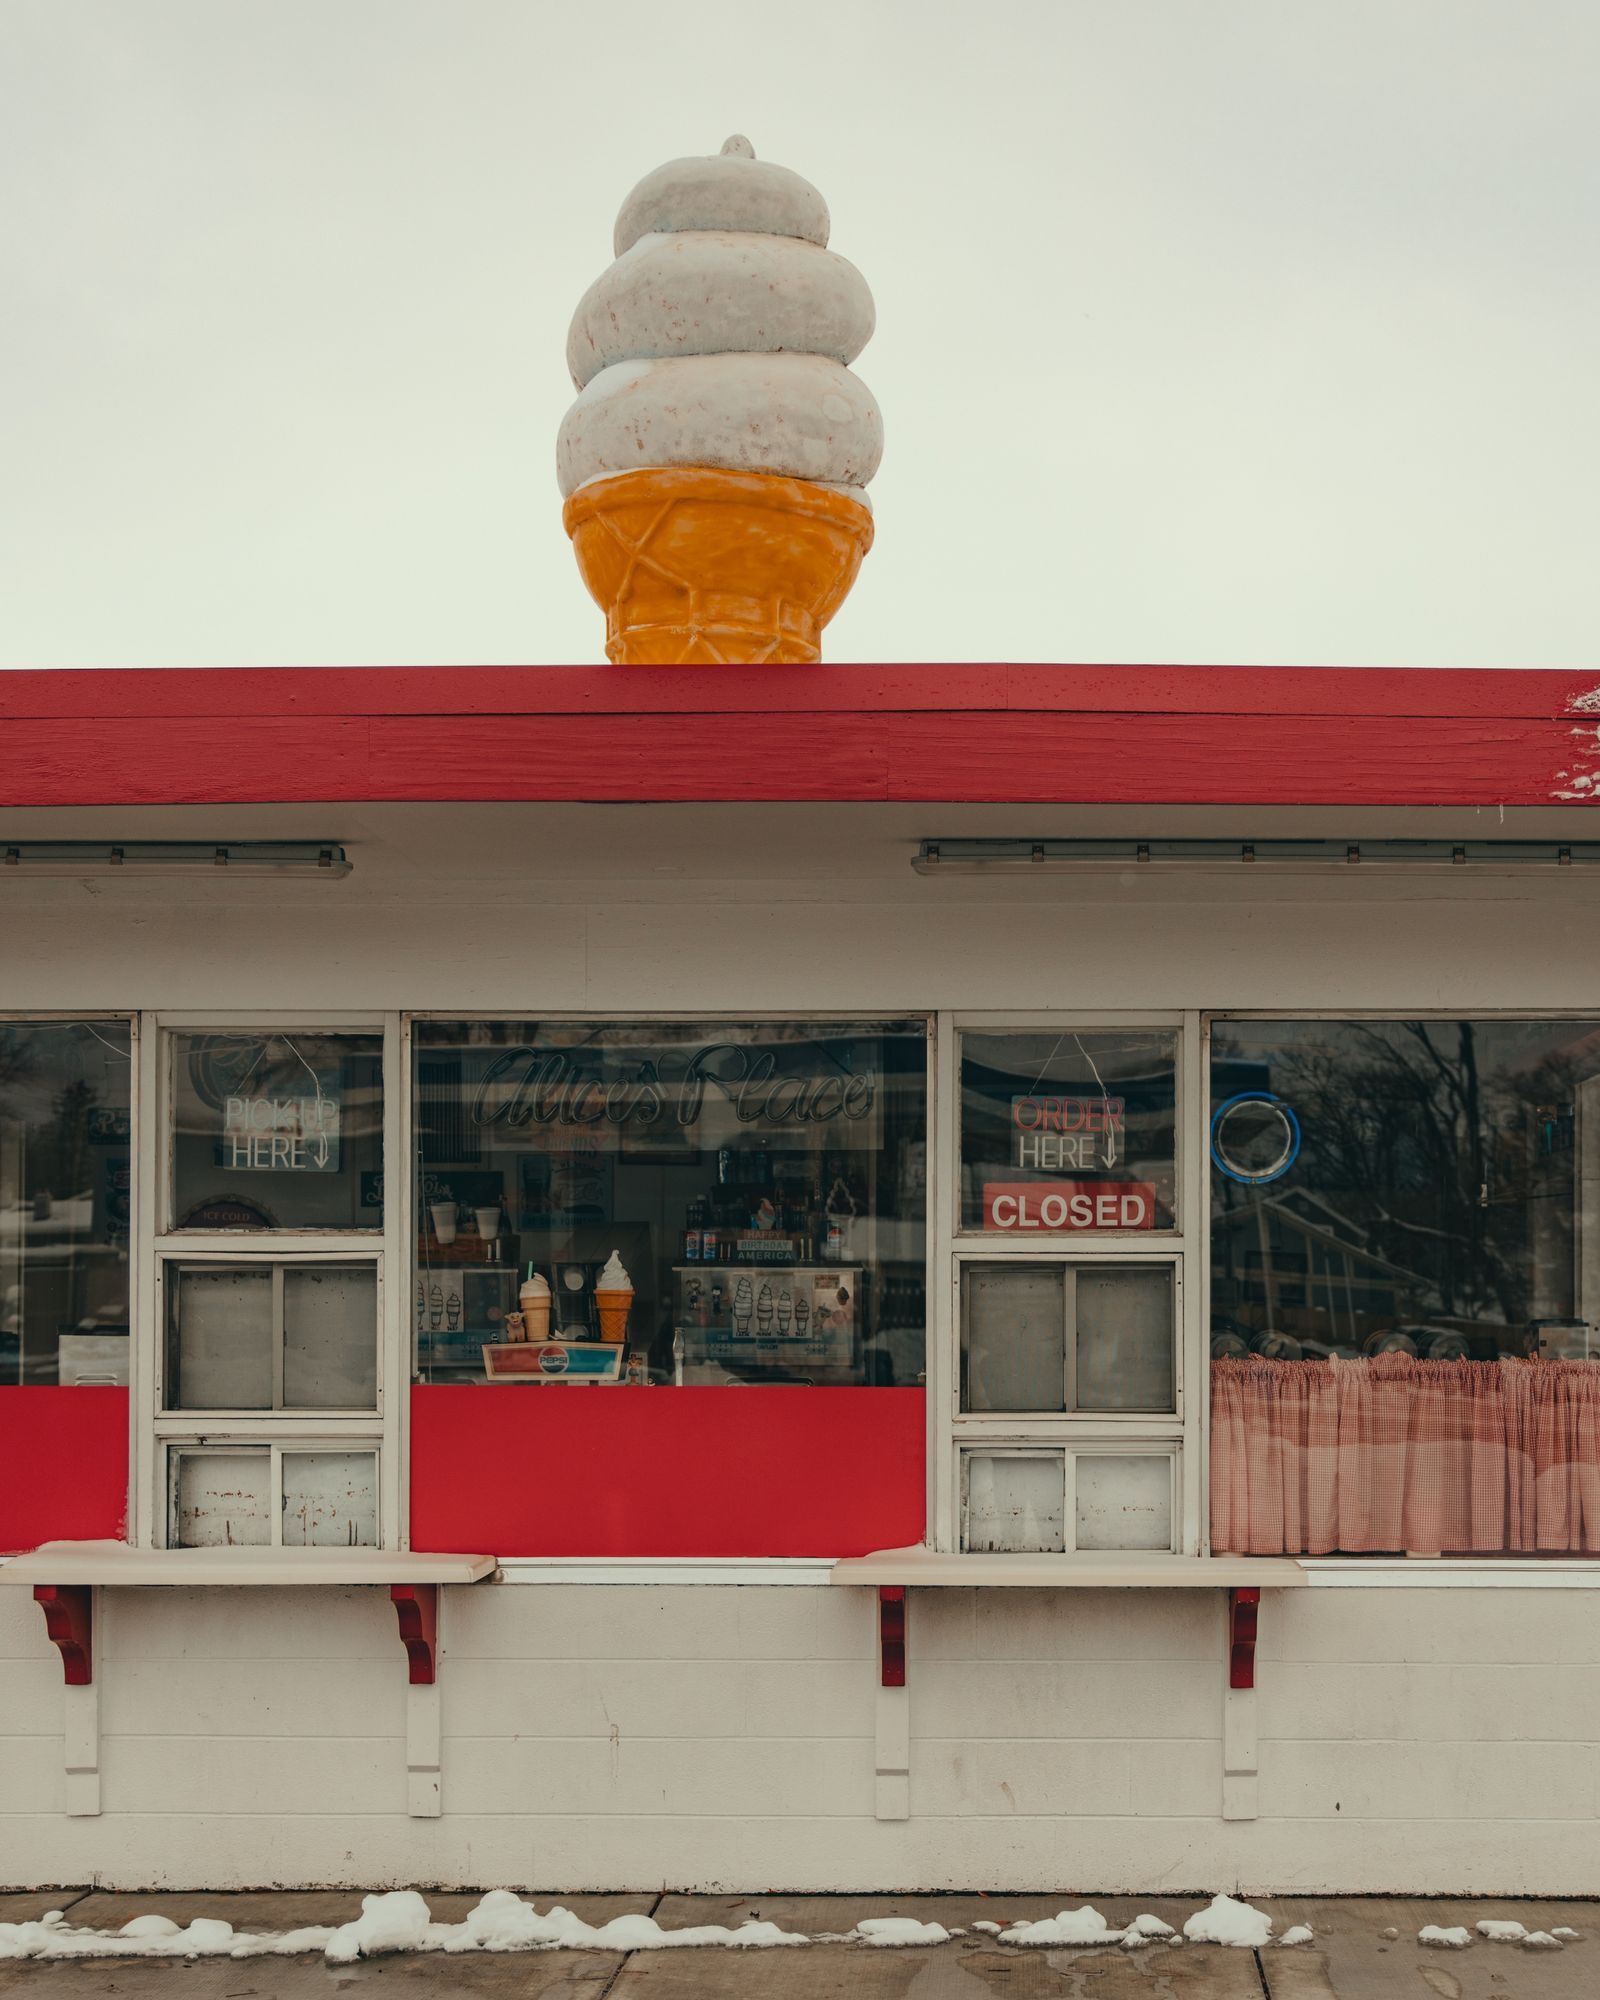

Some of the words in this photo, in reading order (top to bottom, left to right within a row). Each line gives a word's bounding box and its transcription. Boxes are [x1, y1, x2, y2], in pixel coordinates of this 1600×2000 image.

[677, 1042, 870, 1125] Place
[1014, 1098, 1124, 1132] ORDER
[232, 1136, 306, 1169] HERE
[1020, 1136, 1095, 1168] HERE
[203, 1210, 219, 1221] ICE
[222, 1210, 250, 1222] COLD
[991, 1194, 1147, 1227] CLOSED
[741, 1241, 788, 1250] BIRTHDAY
[747, 1230, 781, 1239] HAPPY
[738, 1251, 793, 1260] AMERICA
[539, 1356, 568, 1365] PEPSI
